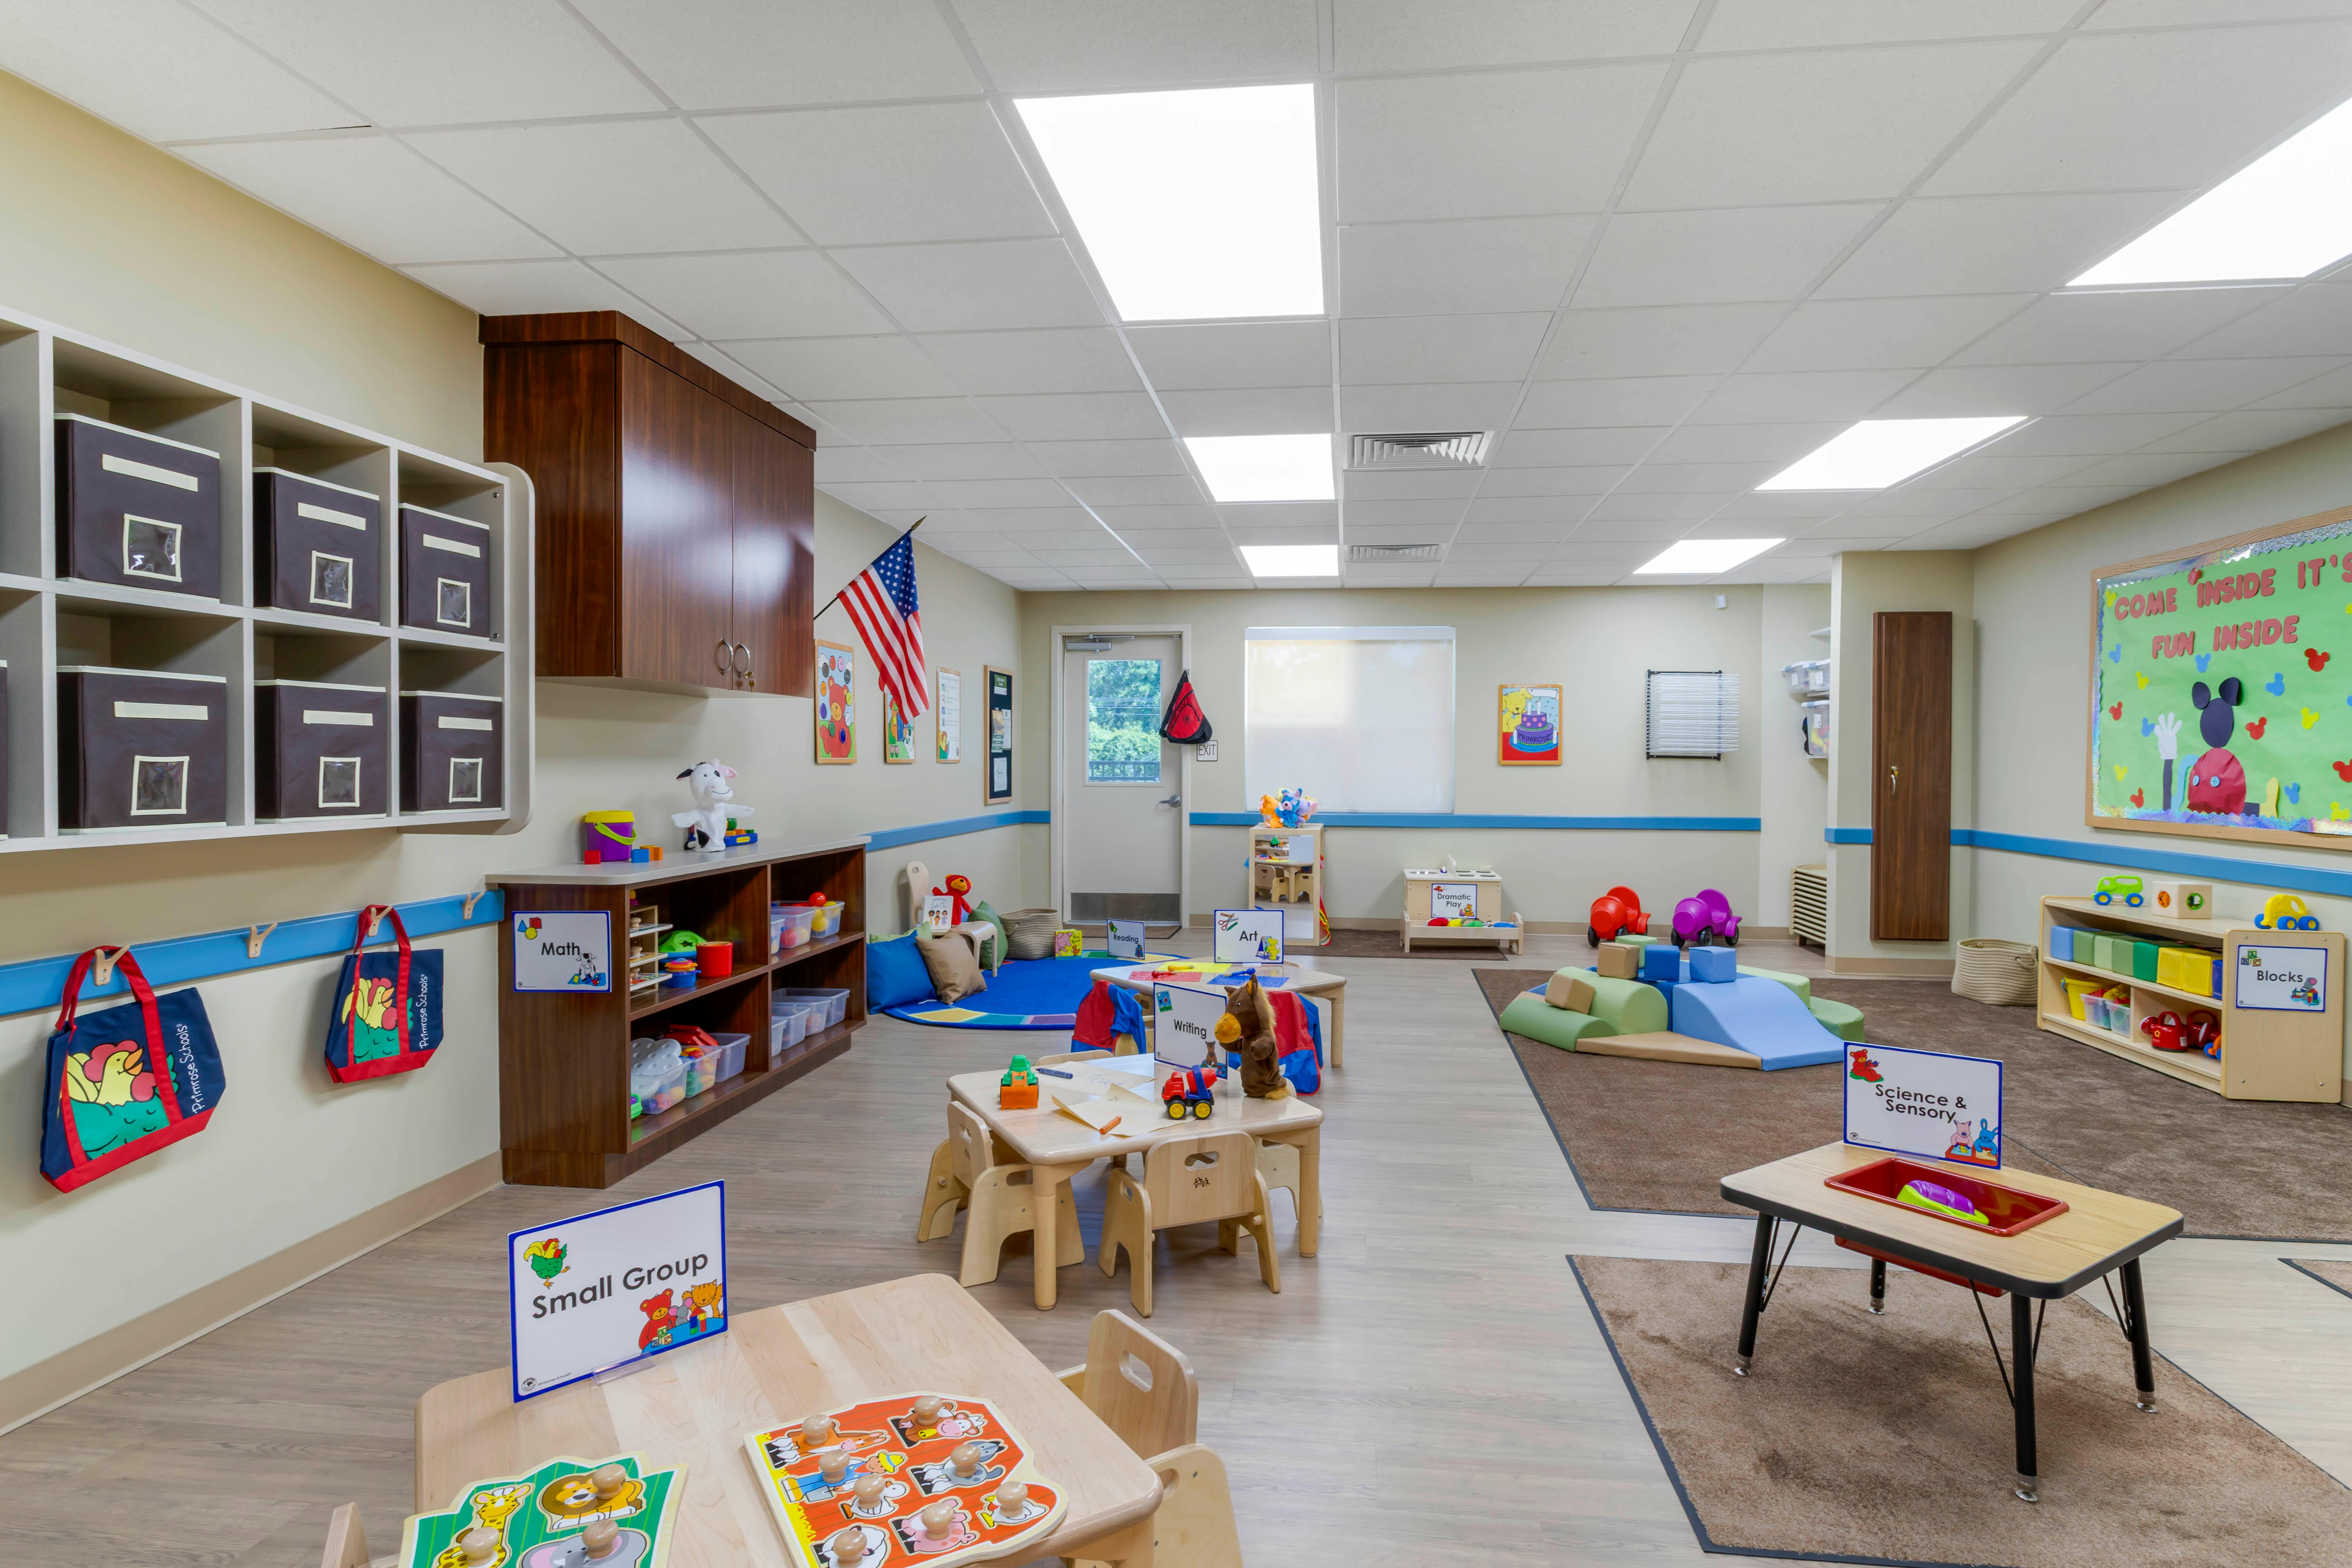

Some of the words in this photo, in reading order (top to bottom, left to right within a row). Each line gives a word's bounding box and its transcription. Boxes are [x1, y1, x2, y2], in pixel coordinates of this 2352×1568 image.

[2114, 587, 2177, 621] COME
[2197, 568, 2276, 608] INSIDE
[2152, 631, 2195, 659] FUN
[2213, 615, 2299, 651] INSIDE
[1199, 745, 1216, 755] EXIT
[1113, 934, 1138, 944] Reading
[1239, 931, 1258, 941] Art
[541, 942, 580, 955] Math
[2257, 970, 2303, 982] Blocks
[419, 1008, 429, 1049] Primrose
[1174, 1019, 1207, 1039] Writing
[187, 1063, 205, 1113] Primrose
[1876, 1084, 1948, 1106] Science
[1955, 1096, 1967, 1109] &
[1886, 1099, 1956, 1123] Sensory
[532, 1275, 612, 1319] Small
[623, 1254, 708, 1290] Group
